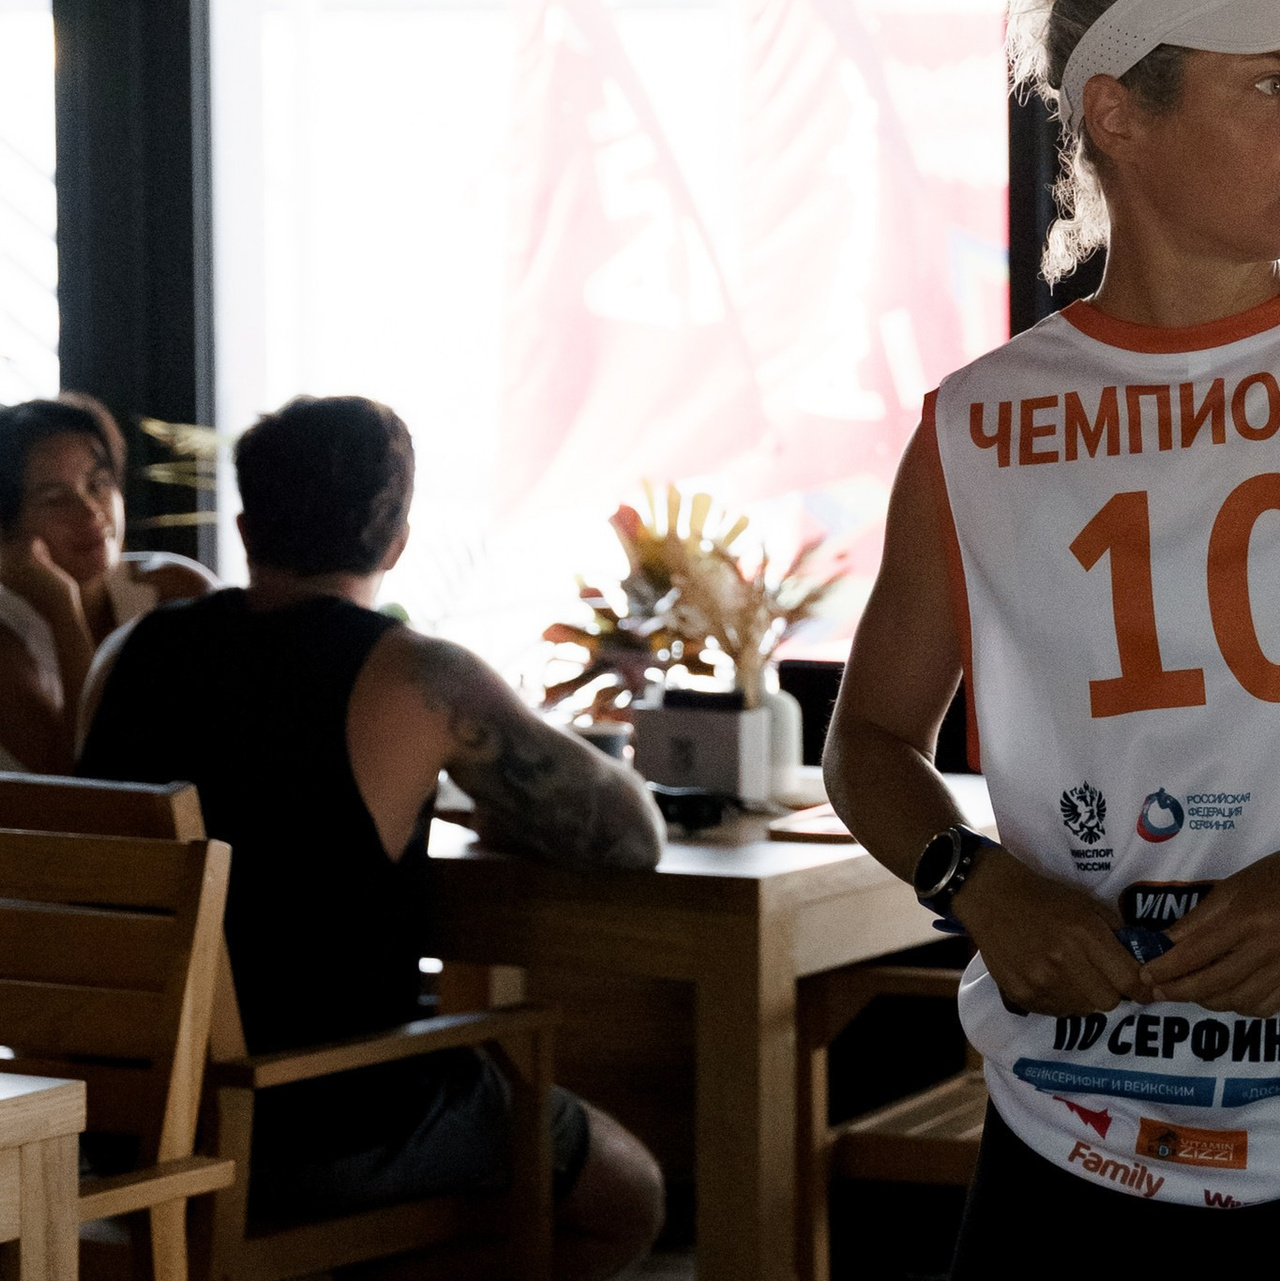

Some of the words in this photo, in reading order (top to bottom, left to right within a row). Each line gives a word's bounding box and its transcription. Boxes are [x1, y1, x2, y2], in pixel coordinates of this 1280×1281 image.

[1187, 792, 1251, 805] РОССИЙСКАЯ
[1188, 806, 1243, 818] ФЕДЕРАЦИЯ
[1189, 820, 1235, 830] СЕРФИНГА
[1111, 1080, 1121, 1091] И
[1124, 1080, 1195, 1097] ВЕЙКСКИМ
[1067, 1140, 1165, 1198] Family
